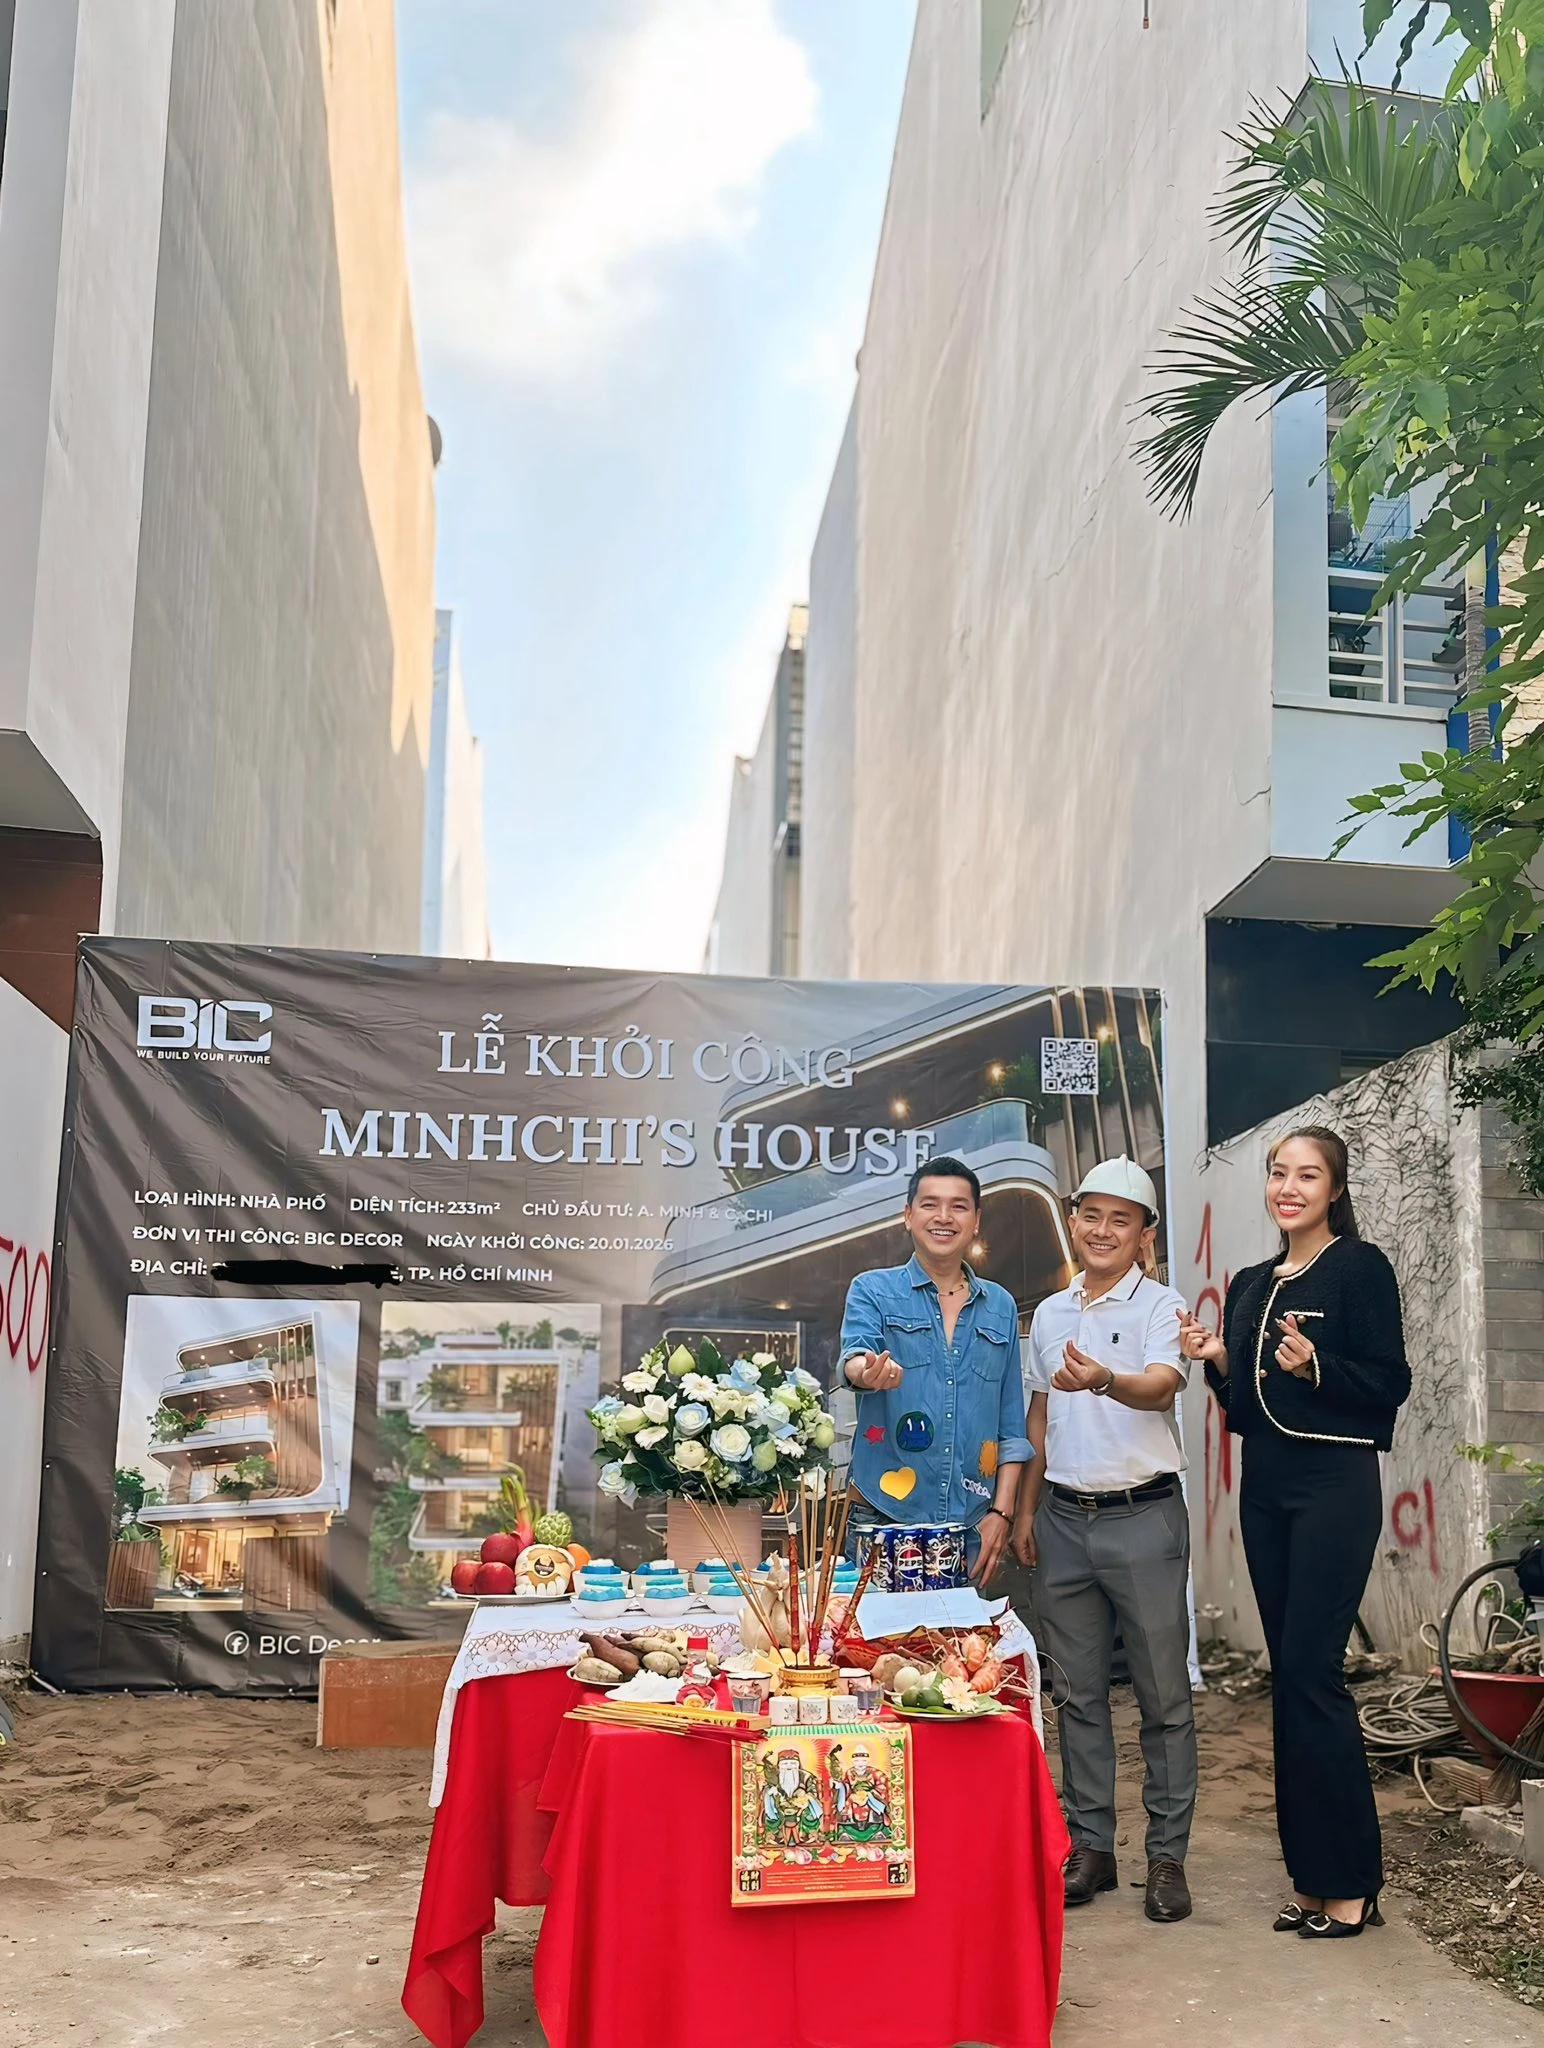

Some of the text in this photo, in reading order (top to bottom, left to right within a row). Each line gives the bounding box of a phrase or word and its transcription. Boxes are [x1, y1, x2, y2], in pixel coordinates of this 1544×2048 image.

[137, 996, 273, 1052] BIC
[136, 1050, 271, 1065] WE BUILD YOUR FUTURE
[437, 1013, 860, 1089] LỄ KHỞI CÔNG
[134, 1190, 327, 1211] LOẠI HÌNH: NHÀ PHỐ
[350, 1196, 501, 1215] DIỆN TÍCH: 233m²
[522, 1199, 773, 1222] CHỦ ĐẦU TƯ: A. MINH & C. CHI
[132, 1225, 403, 1247] ĐƠN VỊ THI CÔNG: BIC DECOR
[427, 1232, 674, 1251] NGÀY KHỞI CÔNG: 20.01.2026
[130, 1258, 165, 1276] ĐỊA
[169, 1257, 208, 1275] CHỈ:
[408, 1266, 435, 1280] TP.
[439, 1263, 466, 1281] HỒ
[471, 1265, 502, 1281] CHÍ
[506, 1267, 553, 1282] MINH
[259, 1635, 302, 1655] BIC
